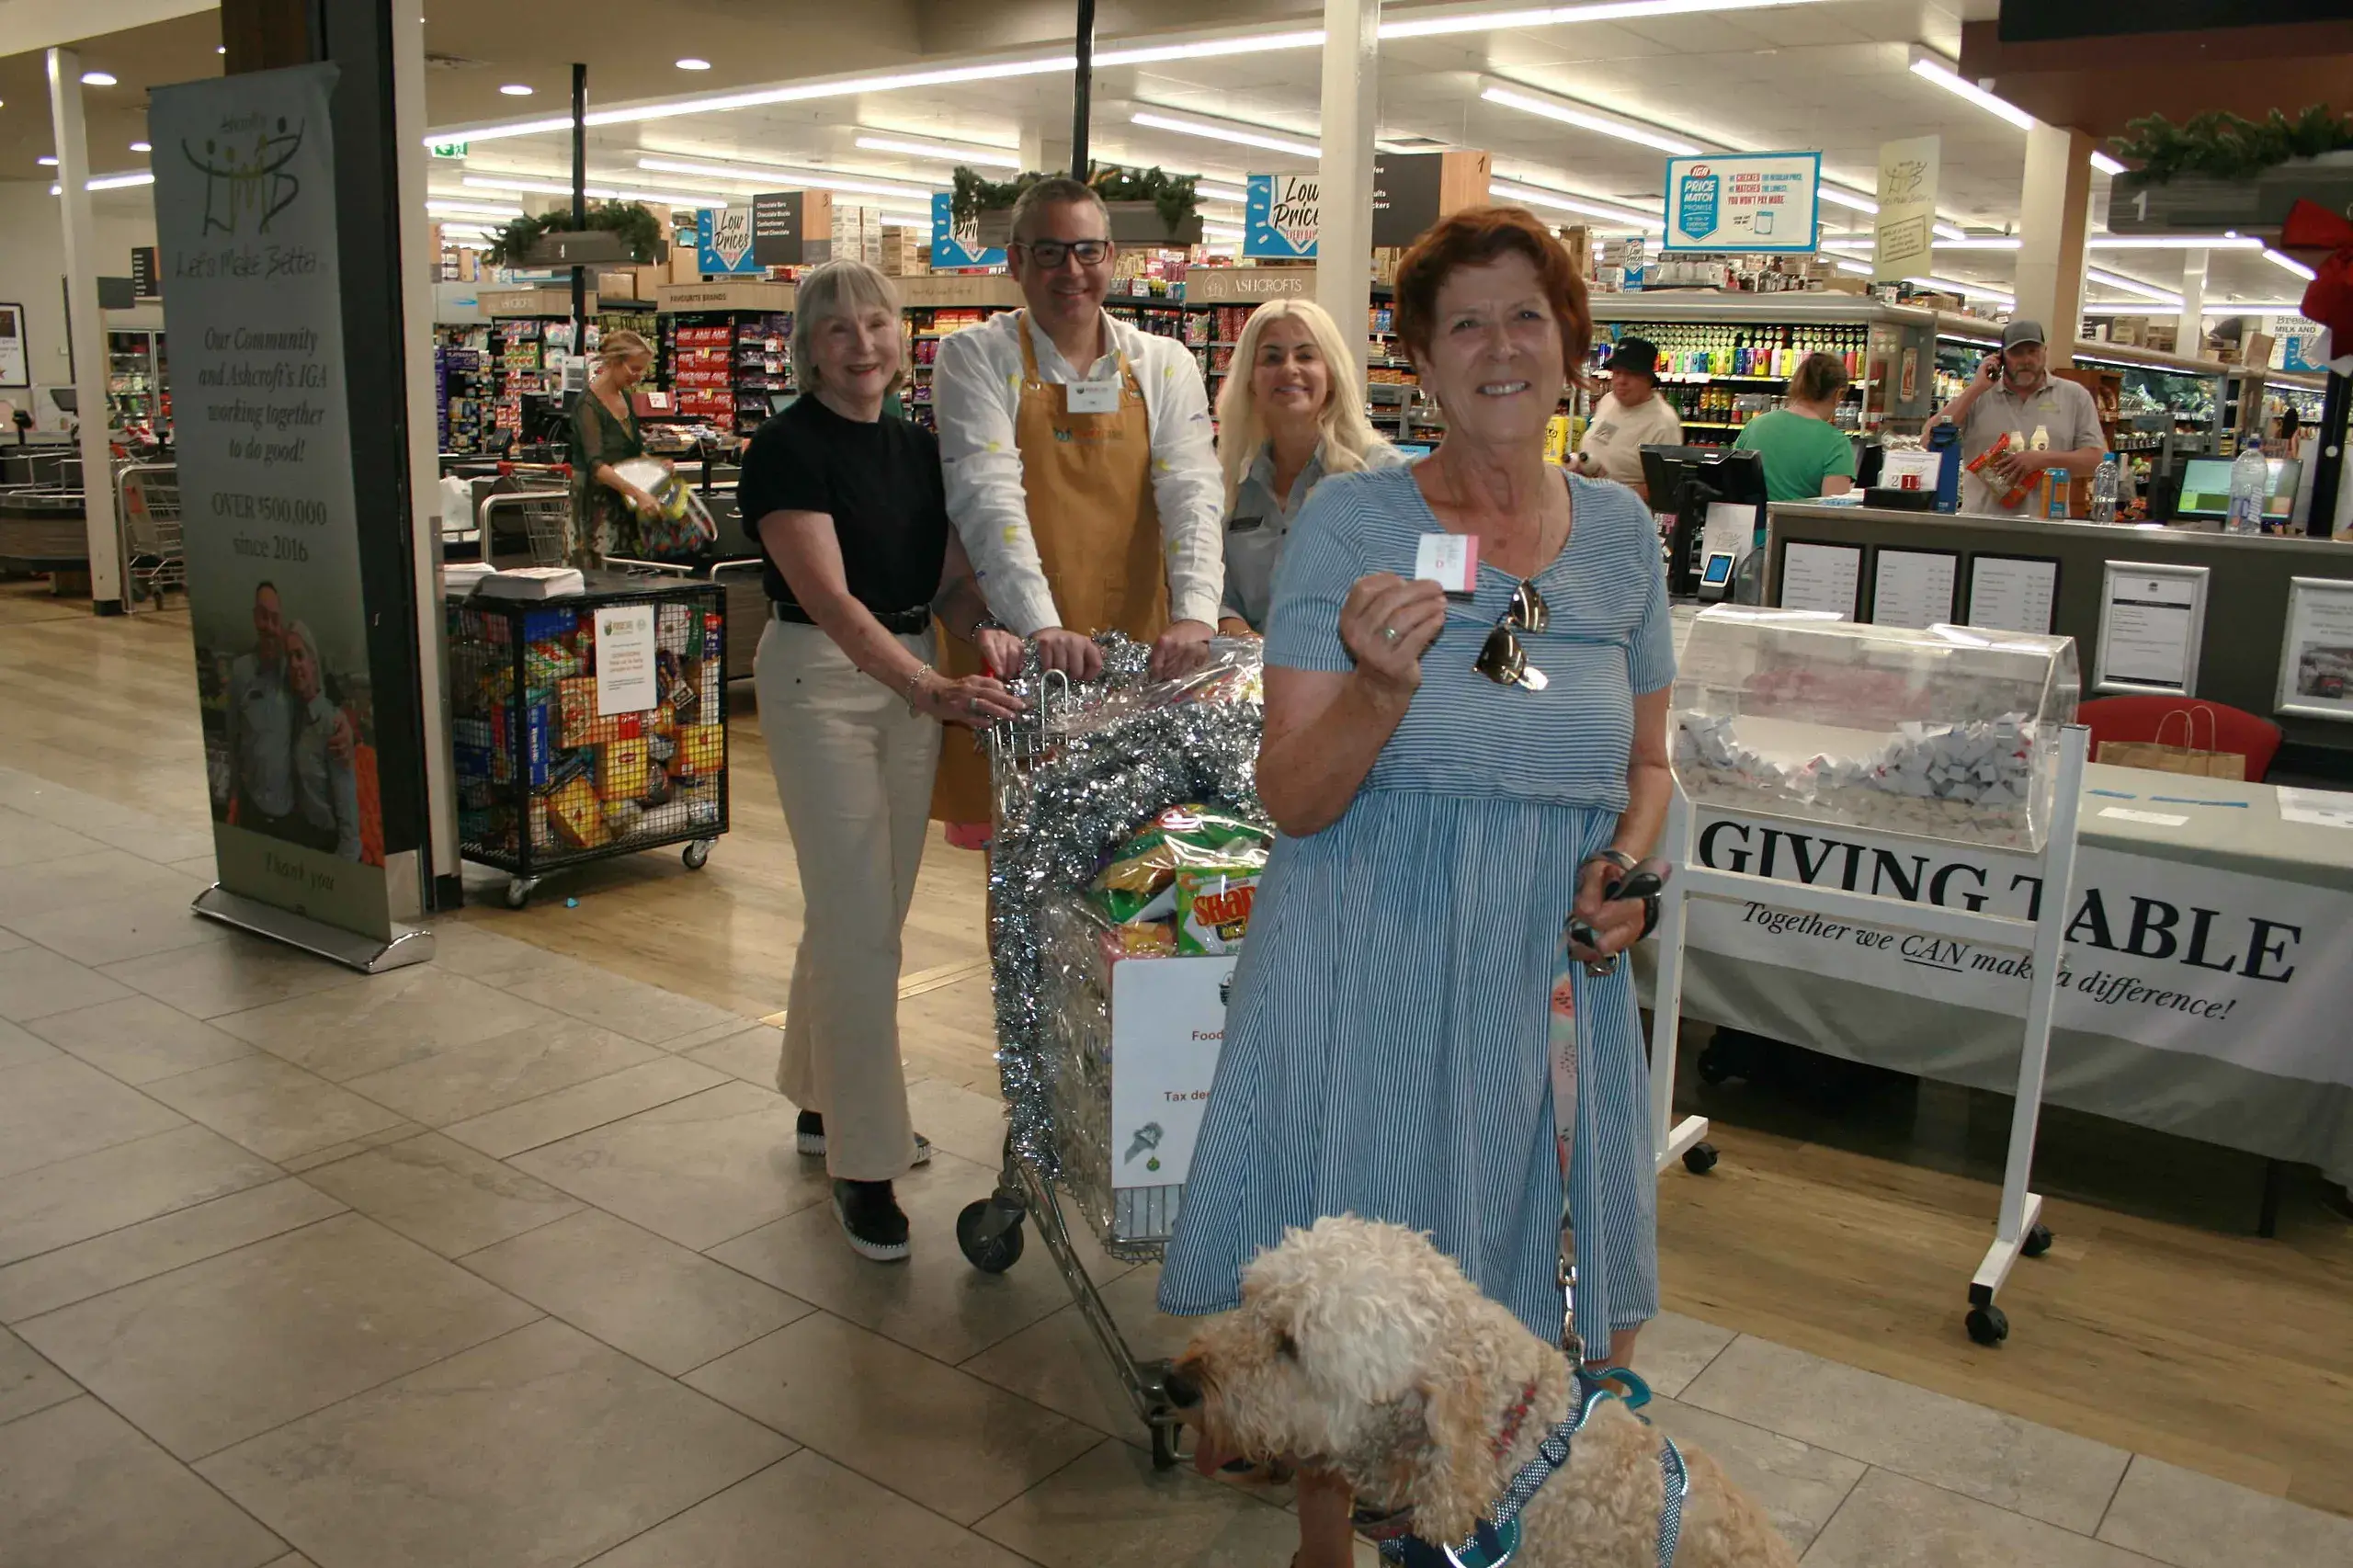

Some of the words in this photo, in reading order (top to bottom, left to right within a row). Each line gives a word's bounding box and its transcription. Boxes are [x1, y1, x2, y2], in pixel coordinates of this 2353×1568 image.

[1478, 156, 1485, 173] 1
[1692, 166, 1709, 176] IGA
[1285, 177, 1320, 203] Low
[1684, 180, 1716, 192] PRICE
[1684, 192, 1714, 203] MATCH
[1735, 185, 1760, 193] MATCHED
[1273, 201, 1320, 229] Pric
[2131, 190, 2147, 221] 1
[721, 210, 744, 230] Low
[714, 229, 750, 254] Prices
[670, 293, 701, 303] FAVOURITE
[702, 292, 727, 301] BRANDS
[1234, 278, 1302, 293] ASHCROFTS
[204, 325, 231, 351] Our
[234, 326, 319, 357] Community
[199, 362, 225, 388] and
[228, 361, 295, 393] Ashcroft's
[299, 364, 327, 388] IGA
[208, 398, 263, 431] working
[267, 400, 325, 431] together
[230, 438, 242, 458] to
[245, 436, 261, 460] do
[264, 438, 305, 466] good!
[211, 492, 256, 520] OVER
[258, 495, 327, 526] $500,000
[233, 531, 269, 558] since
[273, 535, 309, 562] 2016
[265, 852, 305, 881] Thank
[310, 872, 334, 892] you
[1699, 821, 1989, 913] GIVING
[1742, 901, 1851, 940] Together
[1856, 928, 1893, 950] we
[1900, 935, 1972, 968] CAN
[1971, 949, 2034, 982] mak
[2056, 970, 2071, 987] a
[2078, 970, 2236, 1020] difference!
[1191, 1029, 1225, 1041] Food
[1164, 1091, 1187, 1102] Tax
